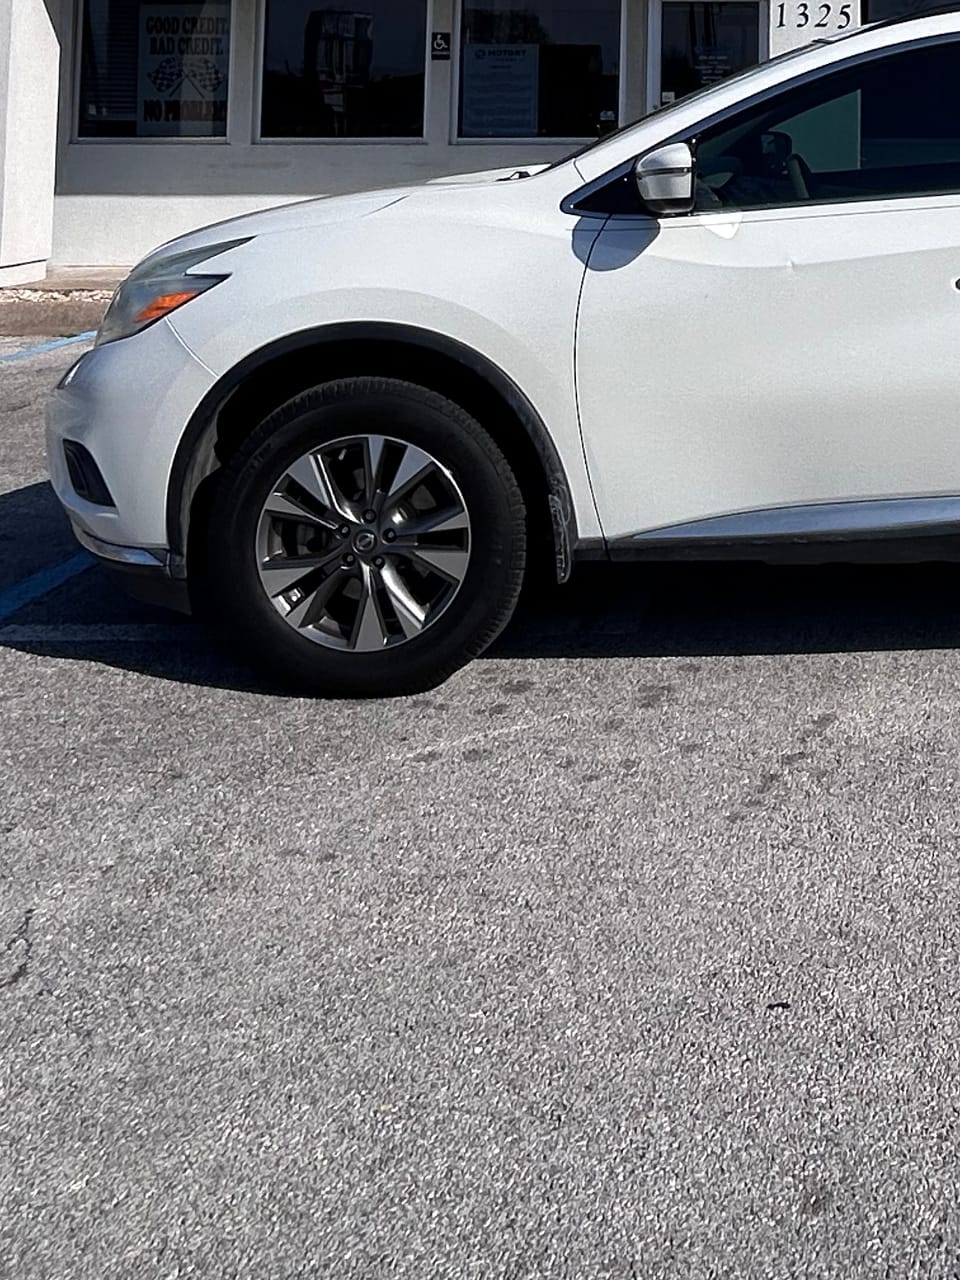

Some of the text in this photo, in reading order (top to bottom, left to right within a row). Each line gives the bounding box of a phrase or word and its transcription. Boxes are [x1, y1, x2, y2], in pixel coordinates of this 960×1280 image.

[776, 2, 851, 29] 1325
[146, 16, 180, 34] GOOD
[149, 37, 175, 54] BAD
